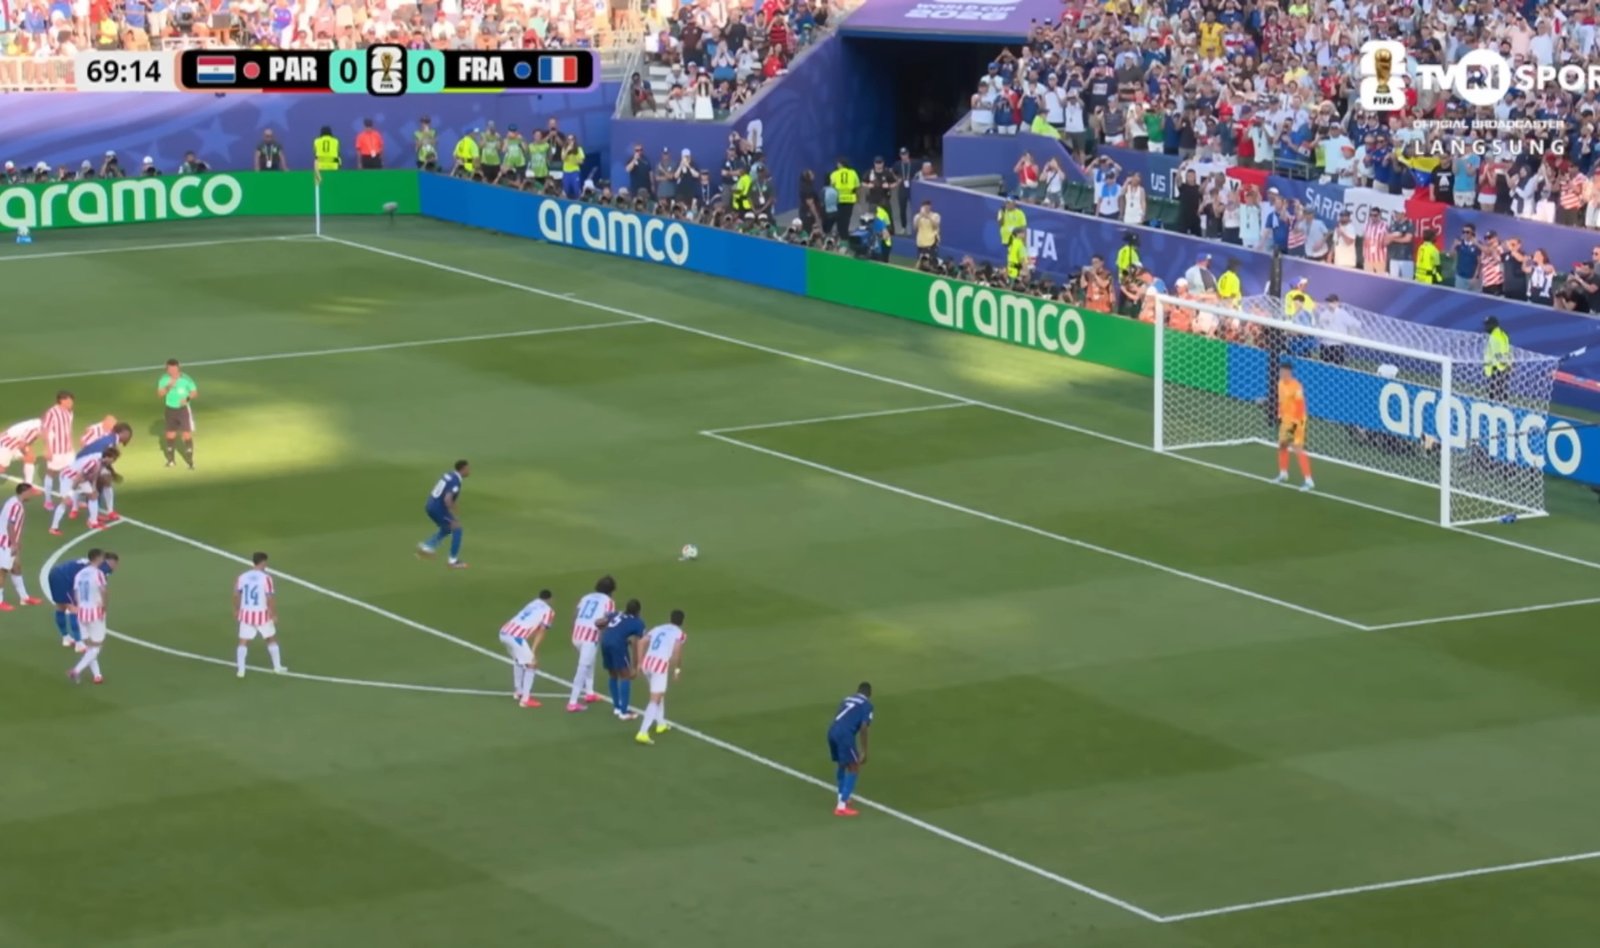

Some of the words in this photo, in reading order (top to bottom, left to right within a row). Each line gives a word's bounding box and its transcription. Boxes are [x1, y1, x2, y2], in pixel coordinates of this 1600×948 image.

[0, 173, 243, 228] aramco
[538, 199, 689, 266] aramco
[1024, 227, 1058, 261] IFA
[928, 279, 1085, 356] aramco
[1379, 382, 1581, 475] aramco
[244, 583, 259, 606] 14
[579, 600, 600, 620] 13
[651, 632, 666, 650] 6
[835, 702, 856, 721] 7
